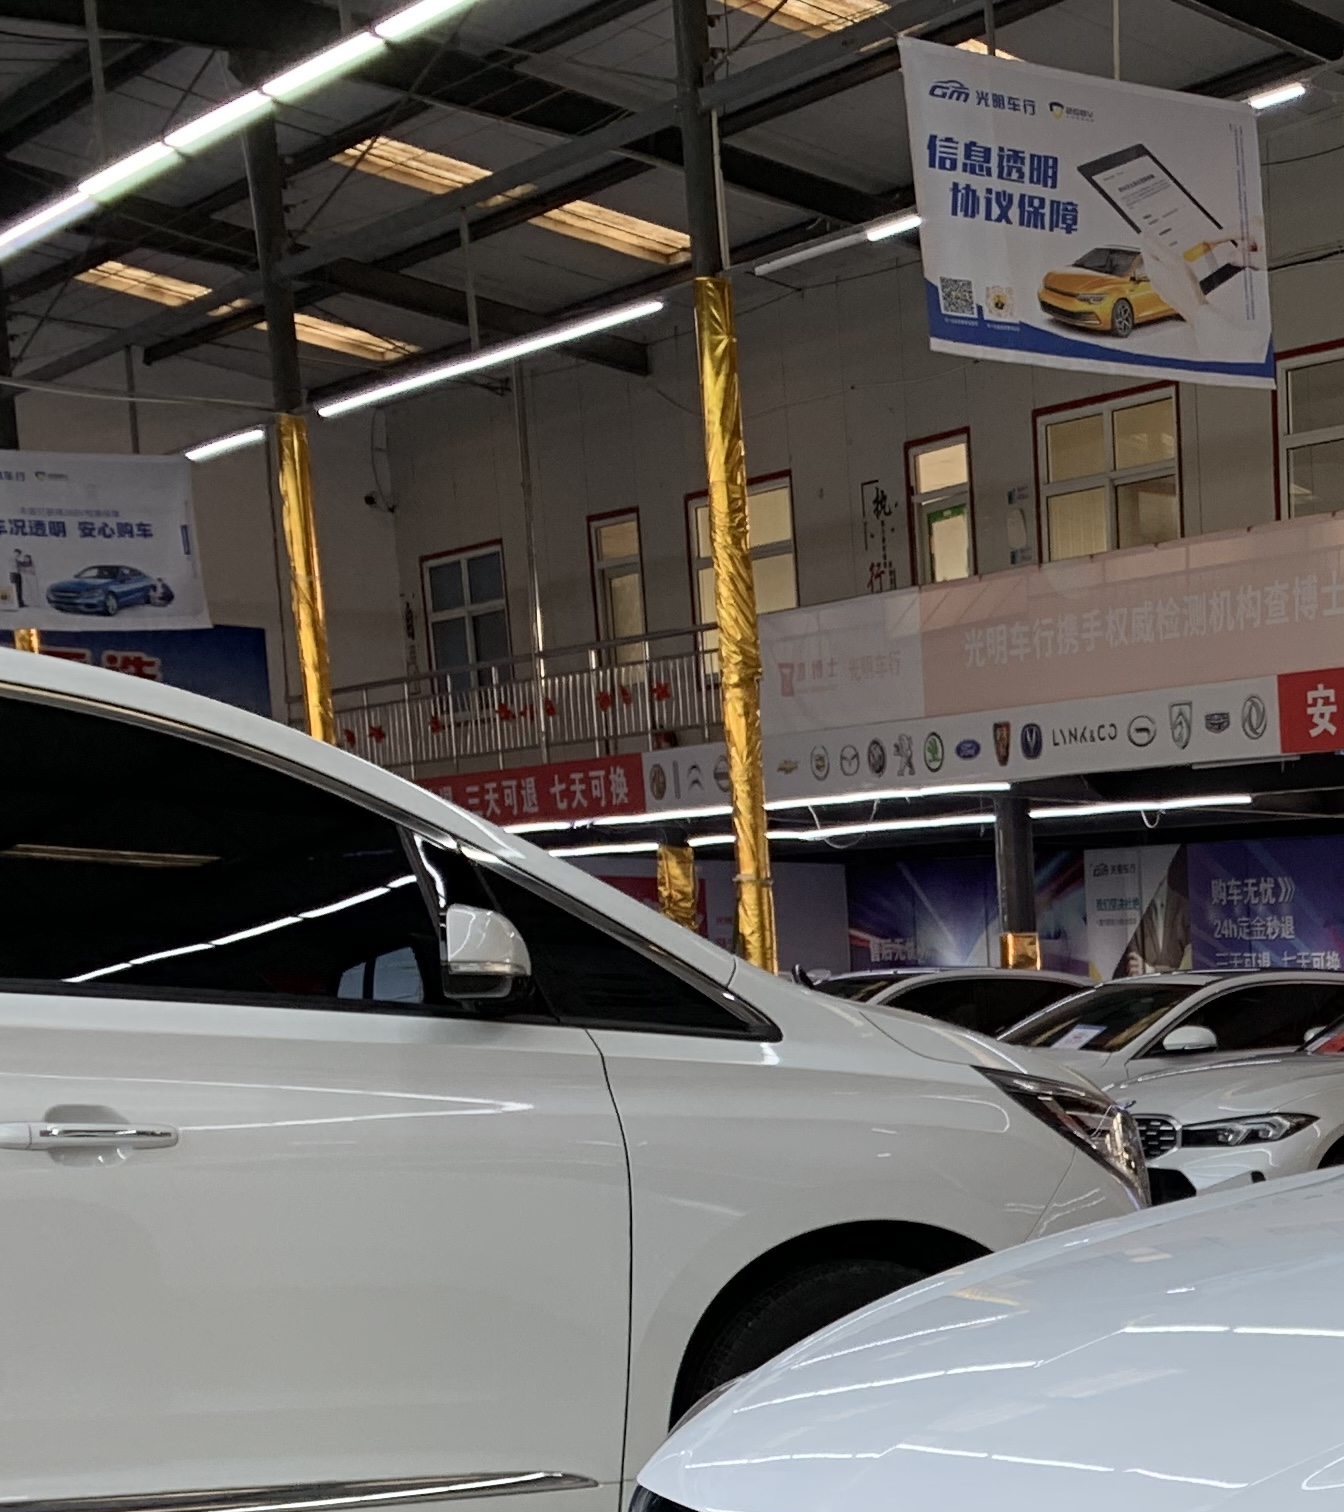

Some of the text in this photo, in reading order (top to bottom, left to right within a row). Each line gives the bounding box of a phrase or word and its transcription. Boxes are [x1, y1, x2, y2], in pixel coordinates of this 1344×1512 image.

[975, 90, 1036, 116] 光明车行
[927, 134, 1059, 189] 信息透明
[949, 181, 1079, 235] 协议保障
[78, 521, 153, 539] 安心购车
[465, 765, 630, 817] 三天可退 七天可换
[1211, 878, 1276, 906] 购车无忧
[1214, 915, 1296, 940] 24h定金秒退
